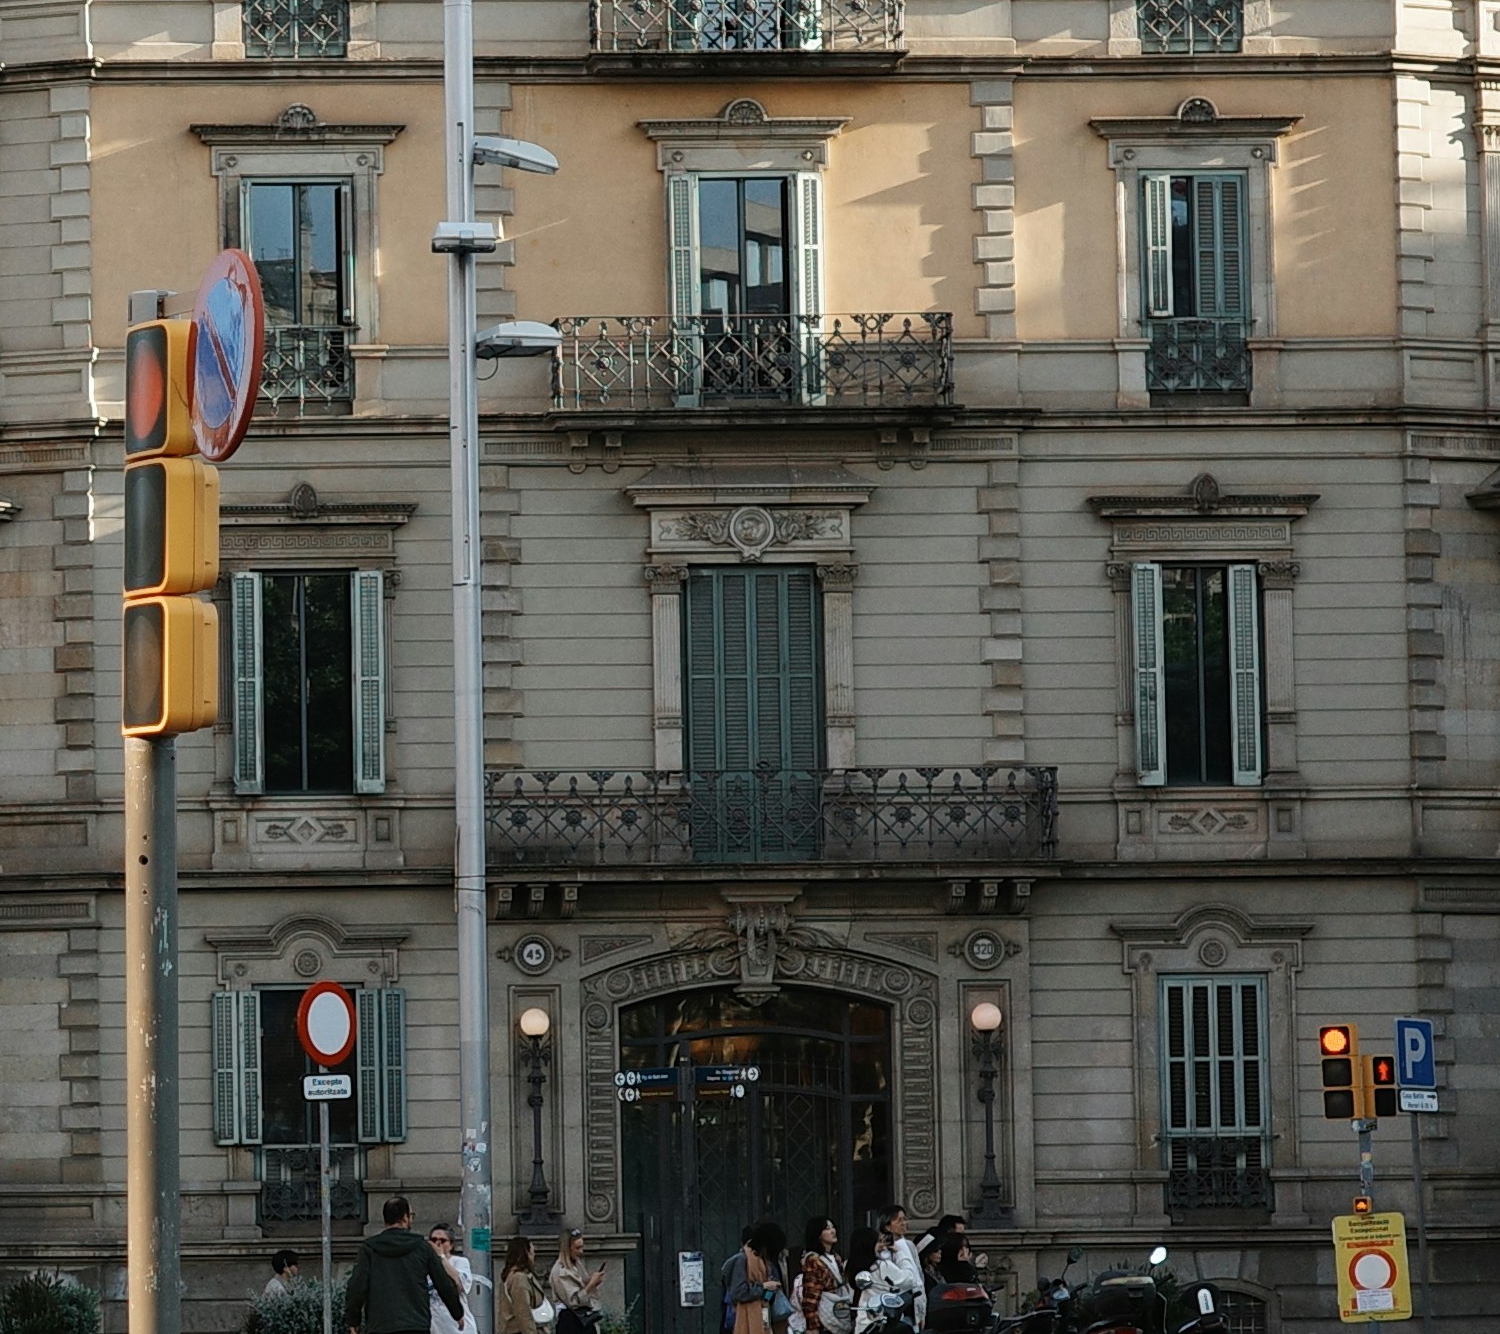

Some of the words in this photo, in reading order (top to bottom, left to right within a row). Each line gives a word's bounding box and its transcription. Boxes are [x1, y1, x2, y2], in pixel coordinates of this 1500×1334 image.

[526, 949, 543, 960] 45
[974, 943, 994, 955] 320
[1404, 1027, 1426, 1079] P
